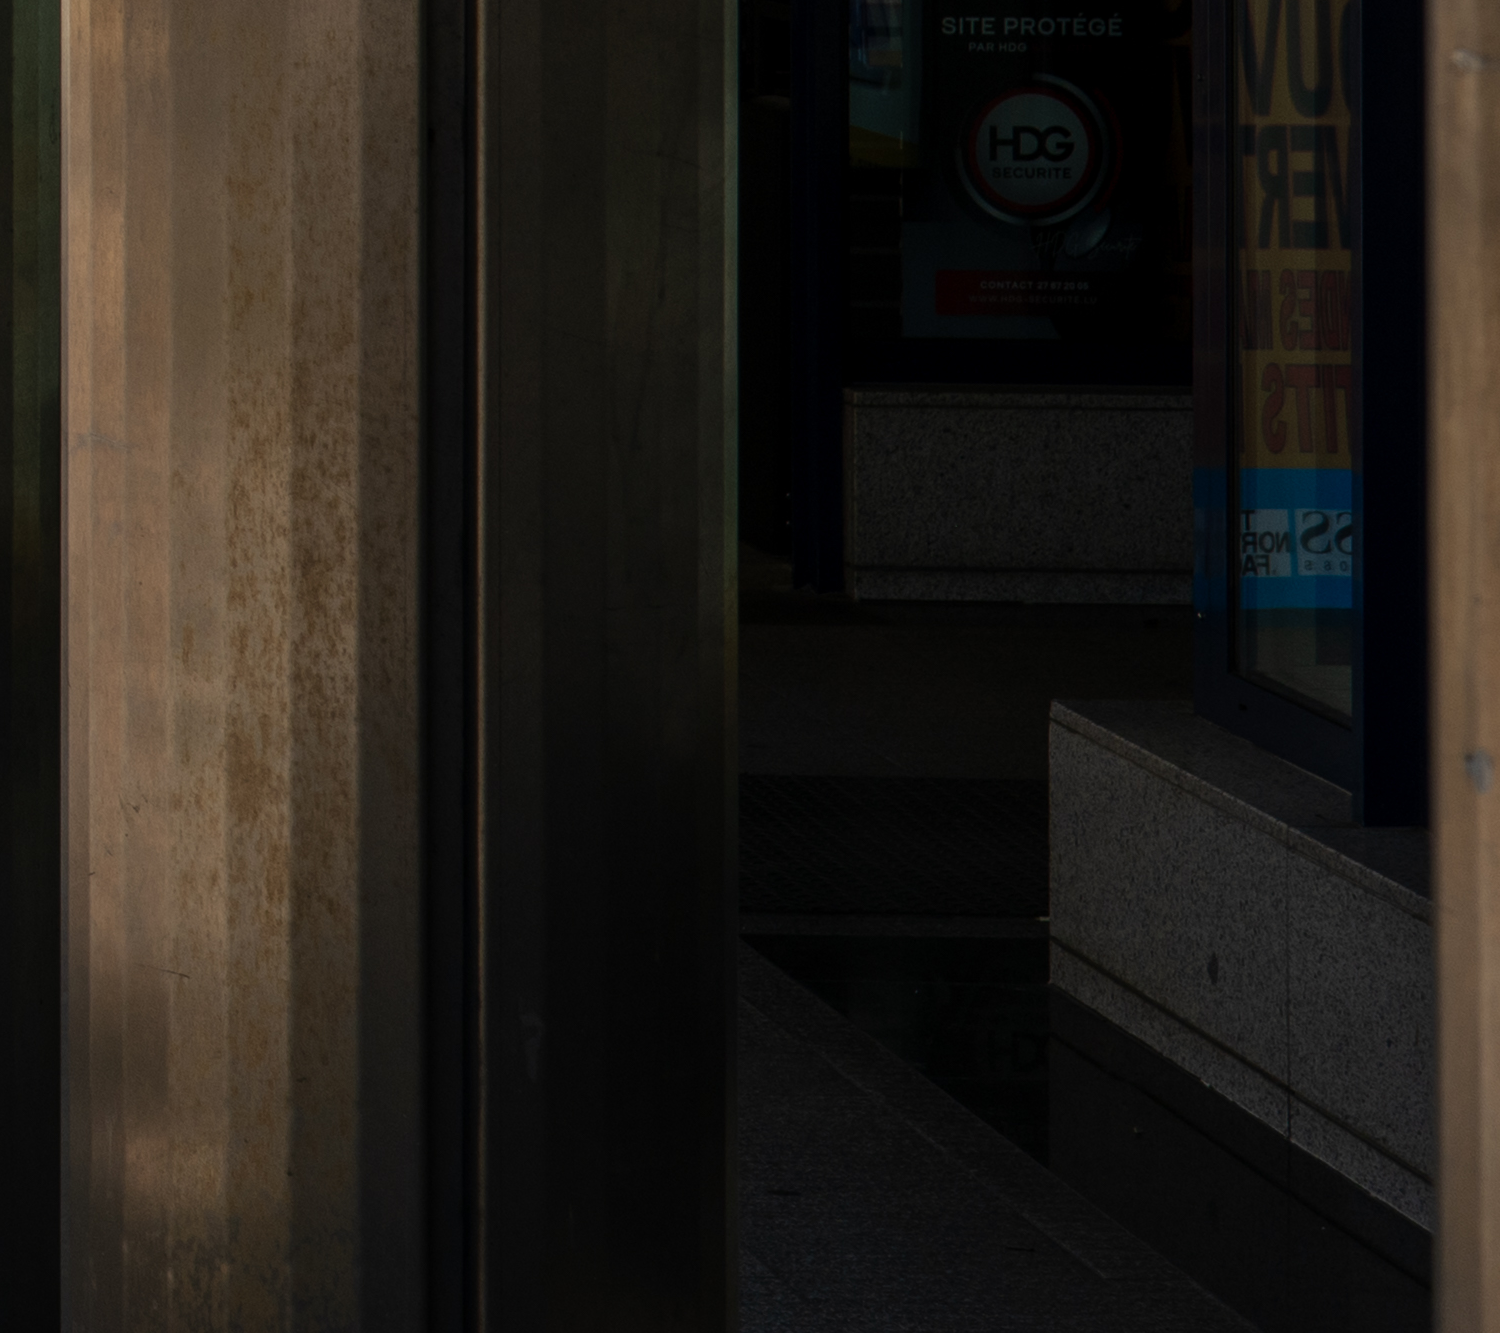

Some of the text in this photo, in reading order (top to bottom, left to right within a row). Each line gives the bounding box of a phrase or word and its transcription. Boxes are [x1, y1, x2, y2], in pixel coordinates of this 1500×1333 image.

[941, 11, 1123, 37] SITE PROTÉGÉ
[968, 41, 995, 53] PAR
[998, 41, 1028, 53] HDG
[989, 125, 1075, 162] HDG
[991, 166, 1073, 180] SECURITE
[979, 280, 1033, 290] CONTACT
